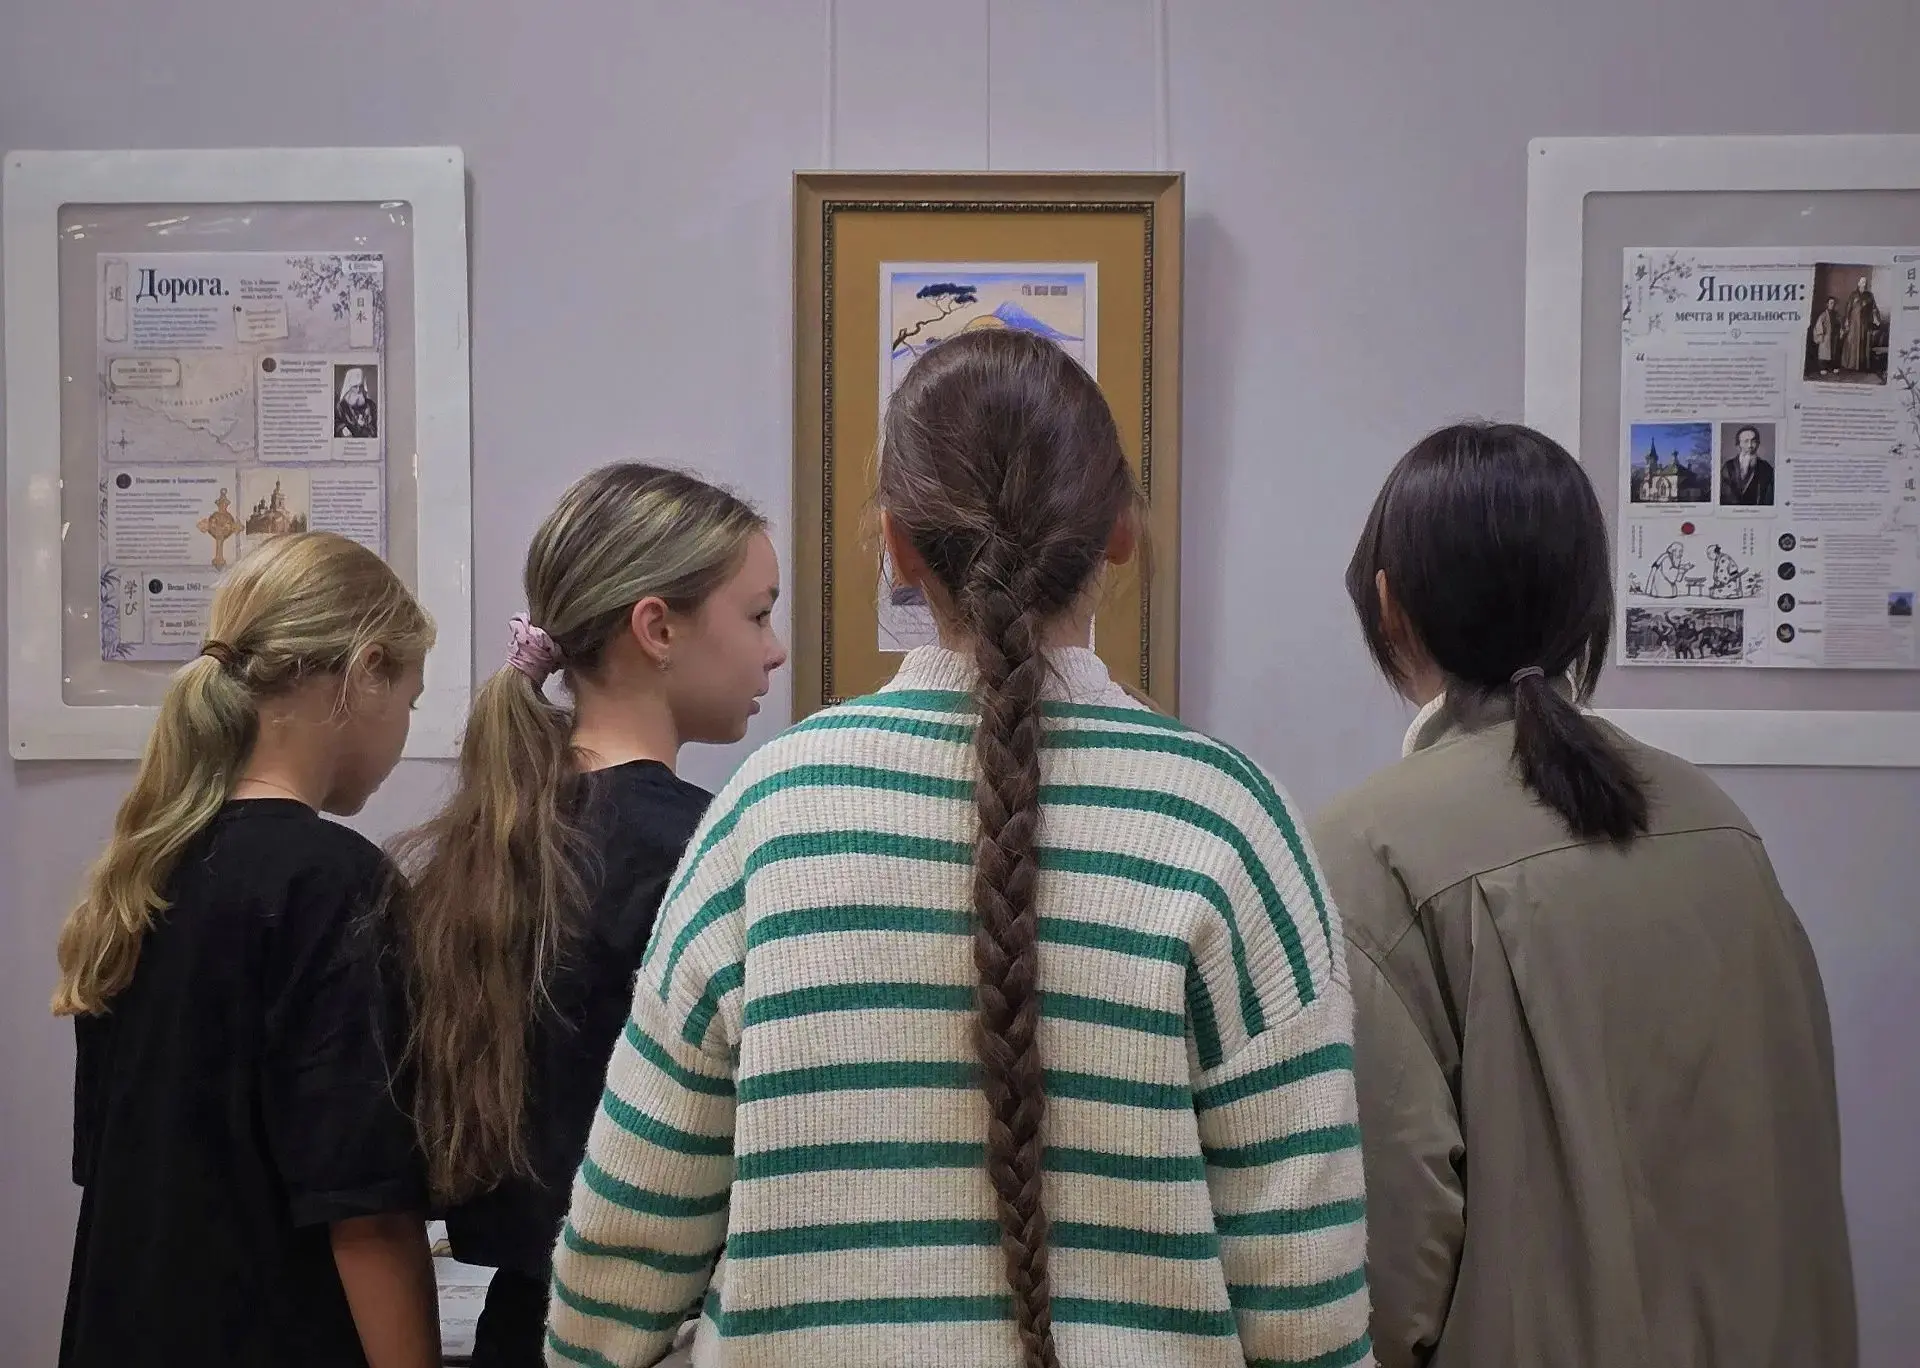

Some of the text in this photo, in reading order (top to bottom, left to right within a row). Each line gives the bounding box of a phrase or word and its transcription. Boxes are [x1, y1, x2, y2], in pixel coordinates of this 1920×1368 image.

[135, 268, 230, 304] Дорога.
[1697, 275, 1805, 302] Япония:
[1674, 310, 1801, 325] мечта и реальность
